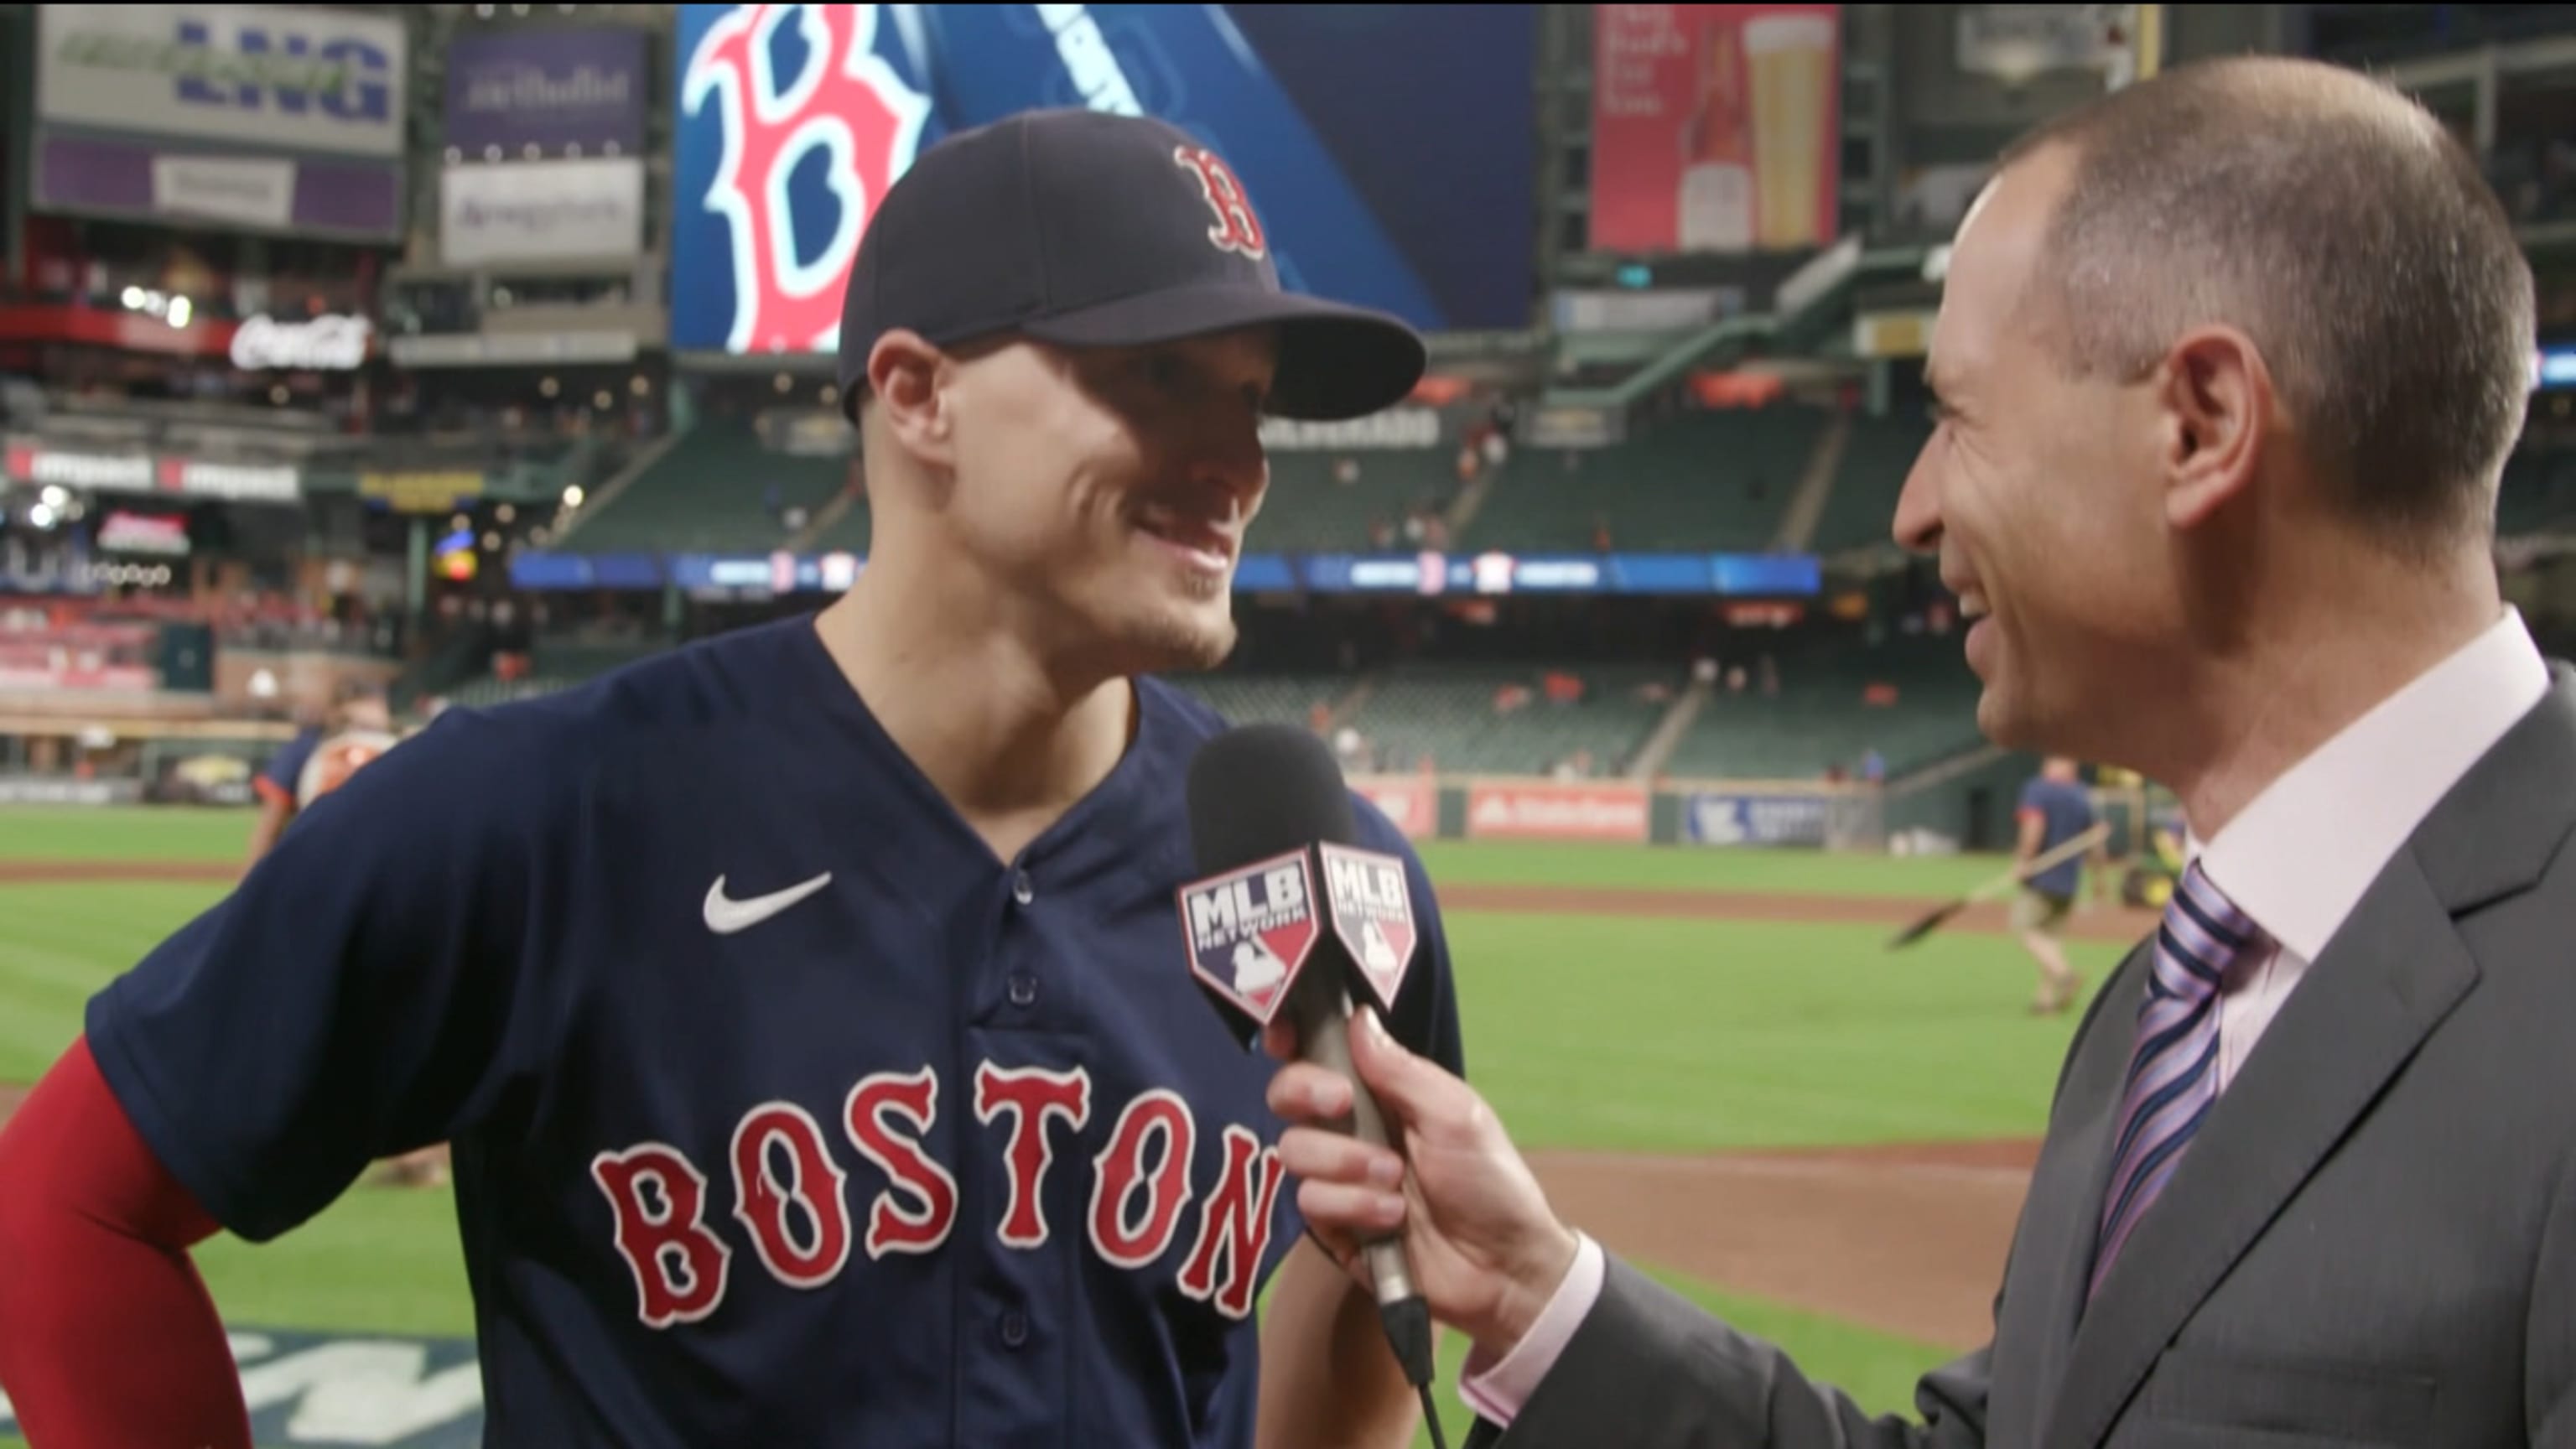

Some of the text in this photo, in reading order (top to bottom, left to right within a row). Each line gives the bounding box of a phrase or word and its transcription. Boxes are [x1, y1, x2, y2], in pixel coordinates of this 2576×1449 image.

[176, 18, 391, 125] LNG
[683, 4, 932, 352] B
[1174, 146, 1265, 261] B
[1190, 862, 1305, 935] MLB
[1197, 901, 1309, 953] NETWORK
[1329, 859, 1404, 910] MLB
[591, 1059, 1286, 1329] BOSTON
